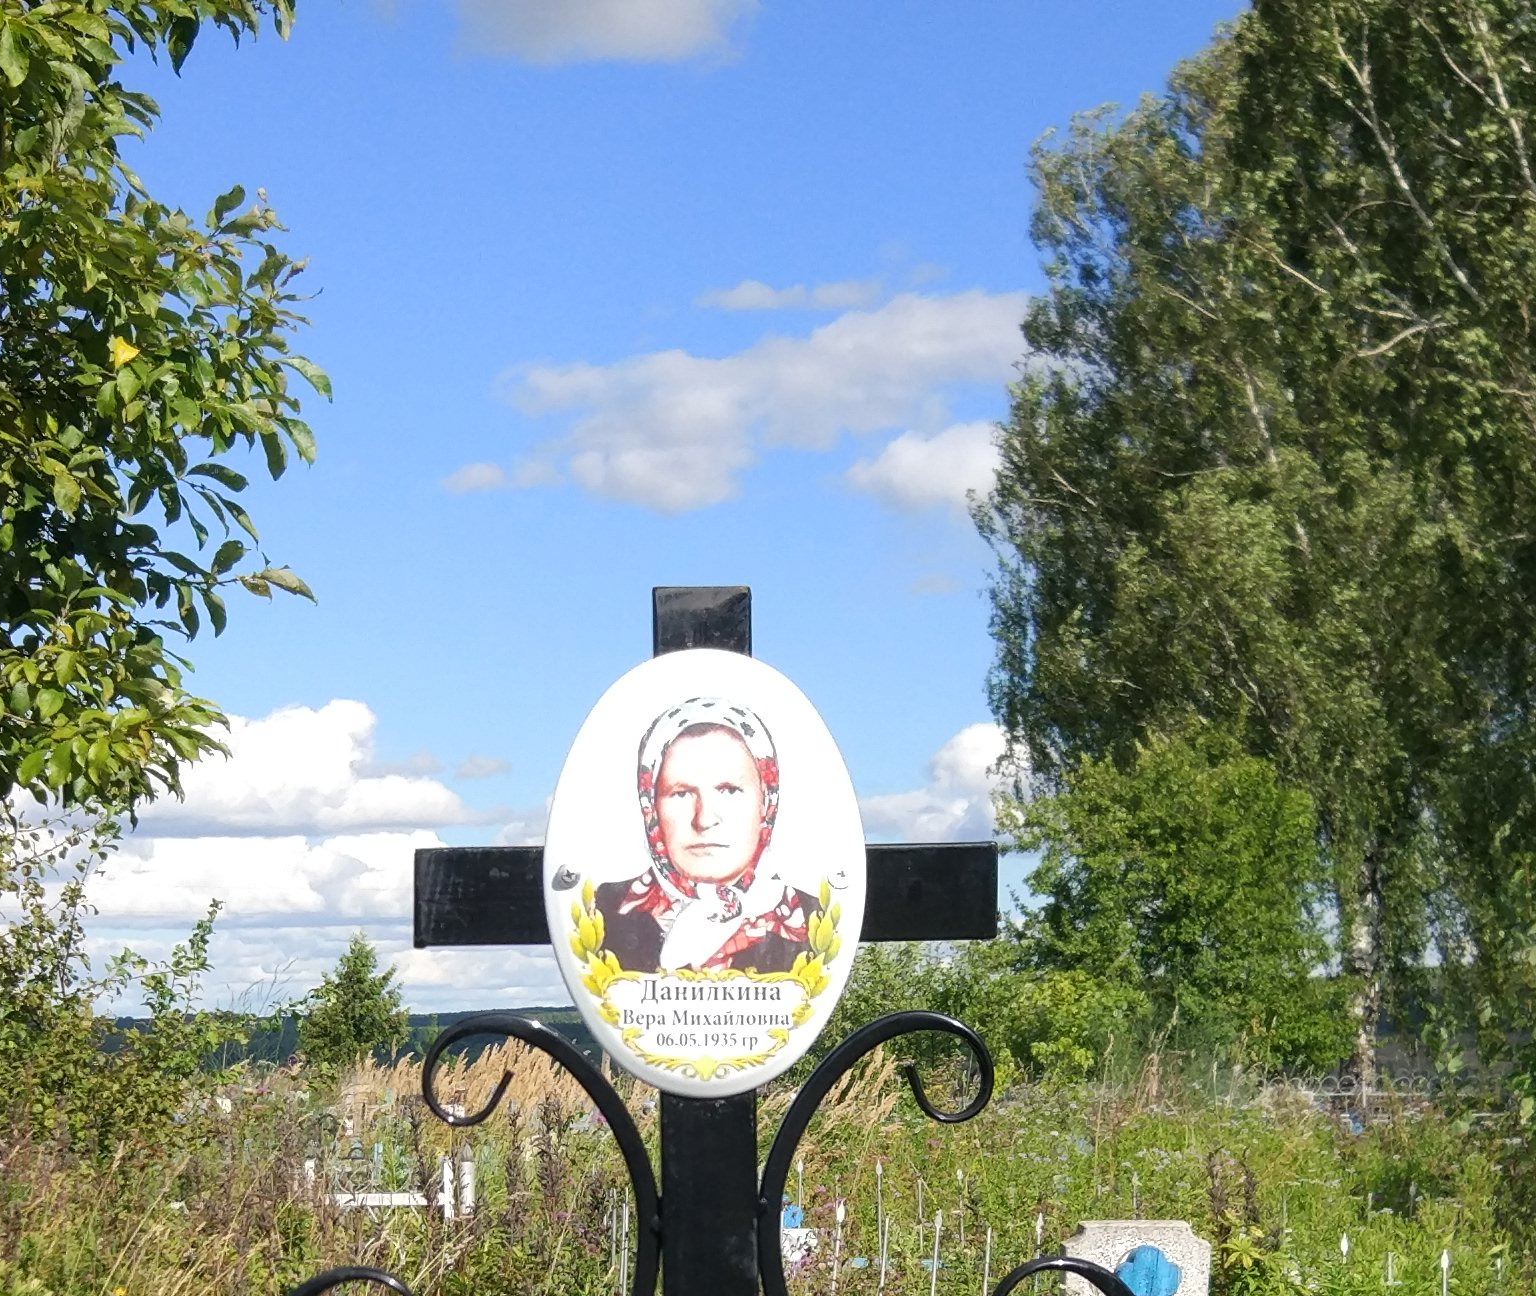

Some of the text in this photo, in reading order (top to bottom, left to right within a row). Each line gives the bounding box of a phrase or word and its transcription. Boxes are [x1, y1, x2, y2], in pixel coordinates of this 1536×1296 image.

[640, 979, 781, 1004] Данилкина
[622, 1009, 790, 1029] Вера Михайловна
[656, 1032, 758, 1050] 06.05.1935 гр
